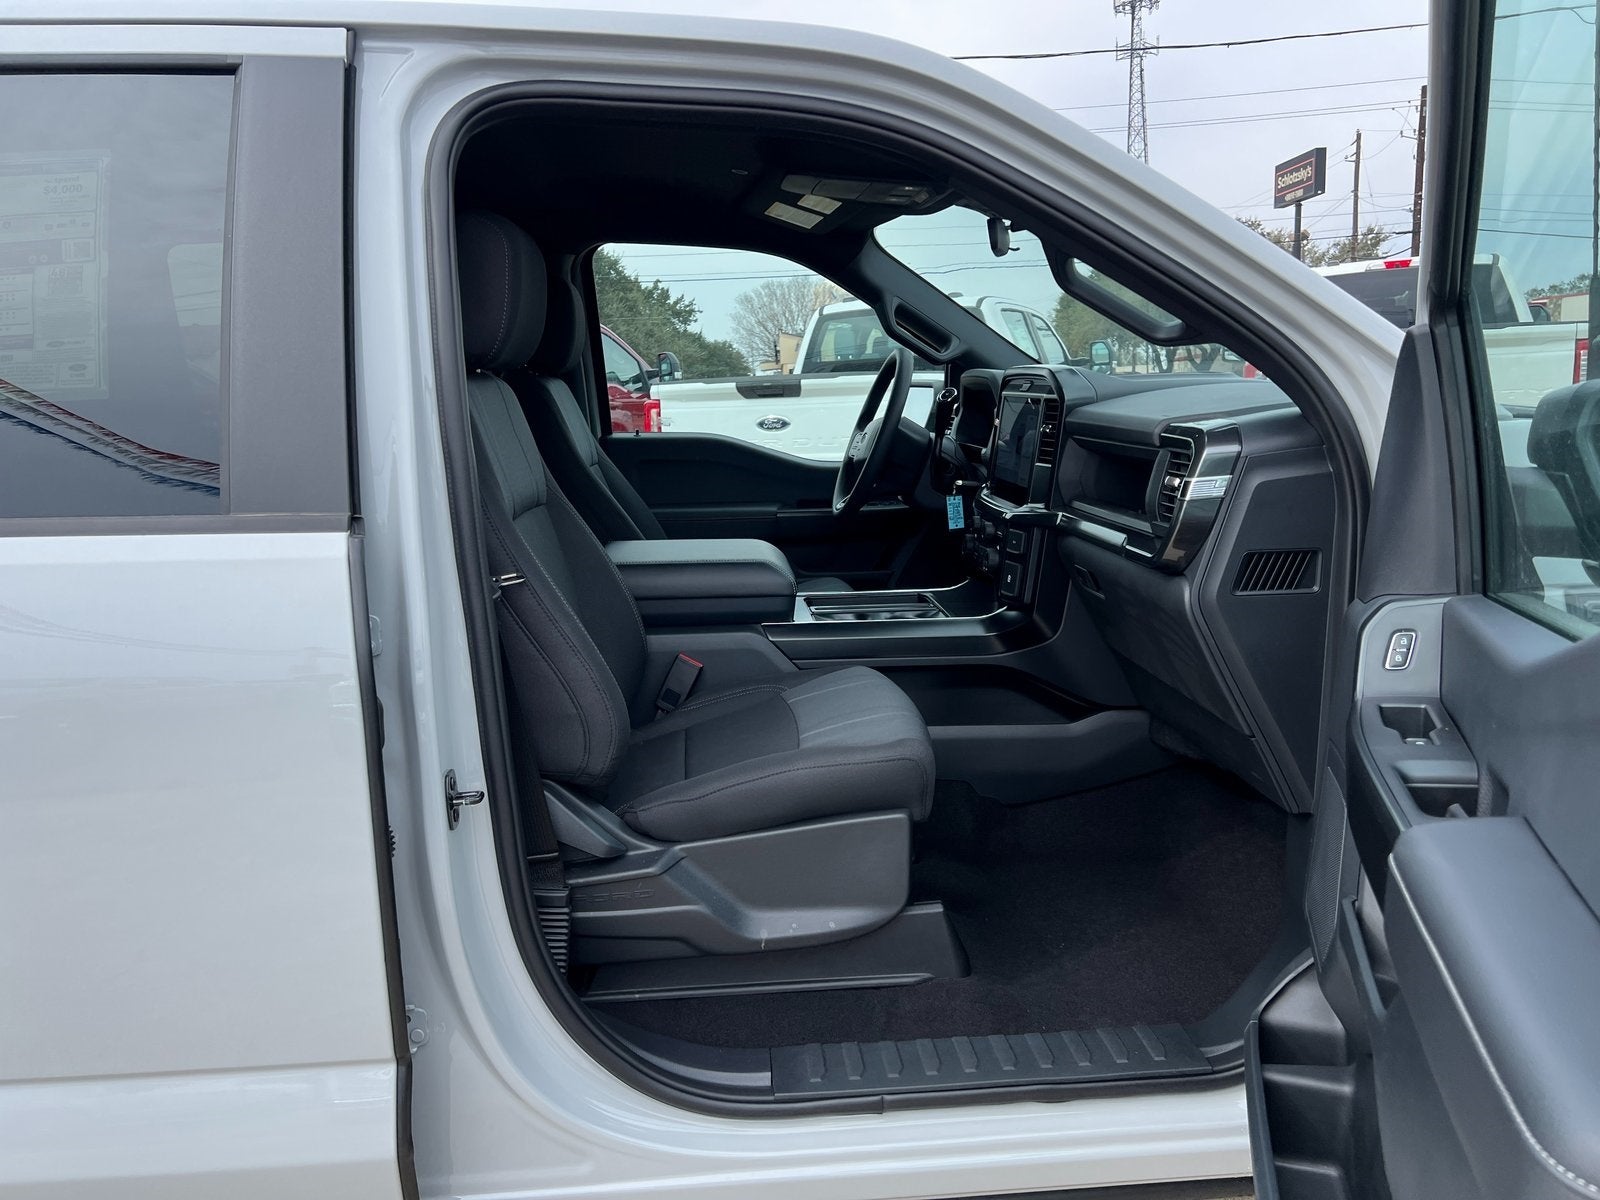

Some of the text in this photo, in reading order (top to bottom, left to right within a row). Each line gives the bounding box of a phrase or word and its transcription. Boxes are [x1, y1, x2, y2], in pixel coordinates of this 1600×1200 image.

[1277, 165, 1312, 189] Schlotzsky's
[43, 183, 83, 196] $4,000
[762, 418, 783, 429] Ford
